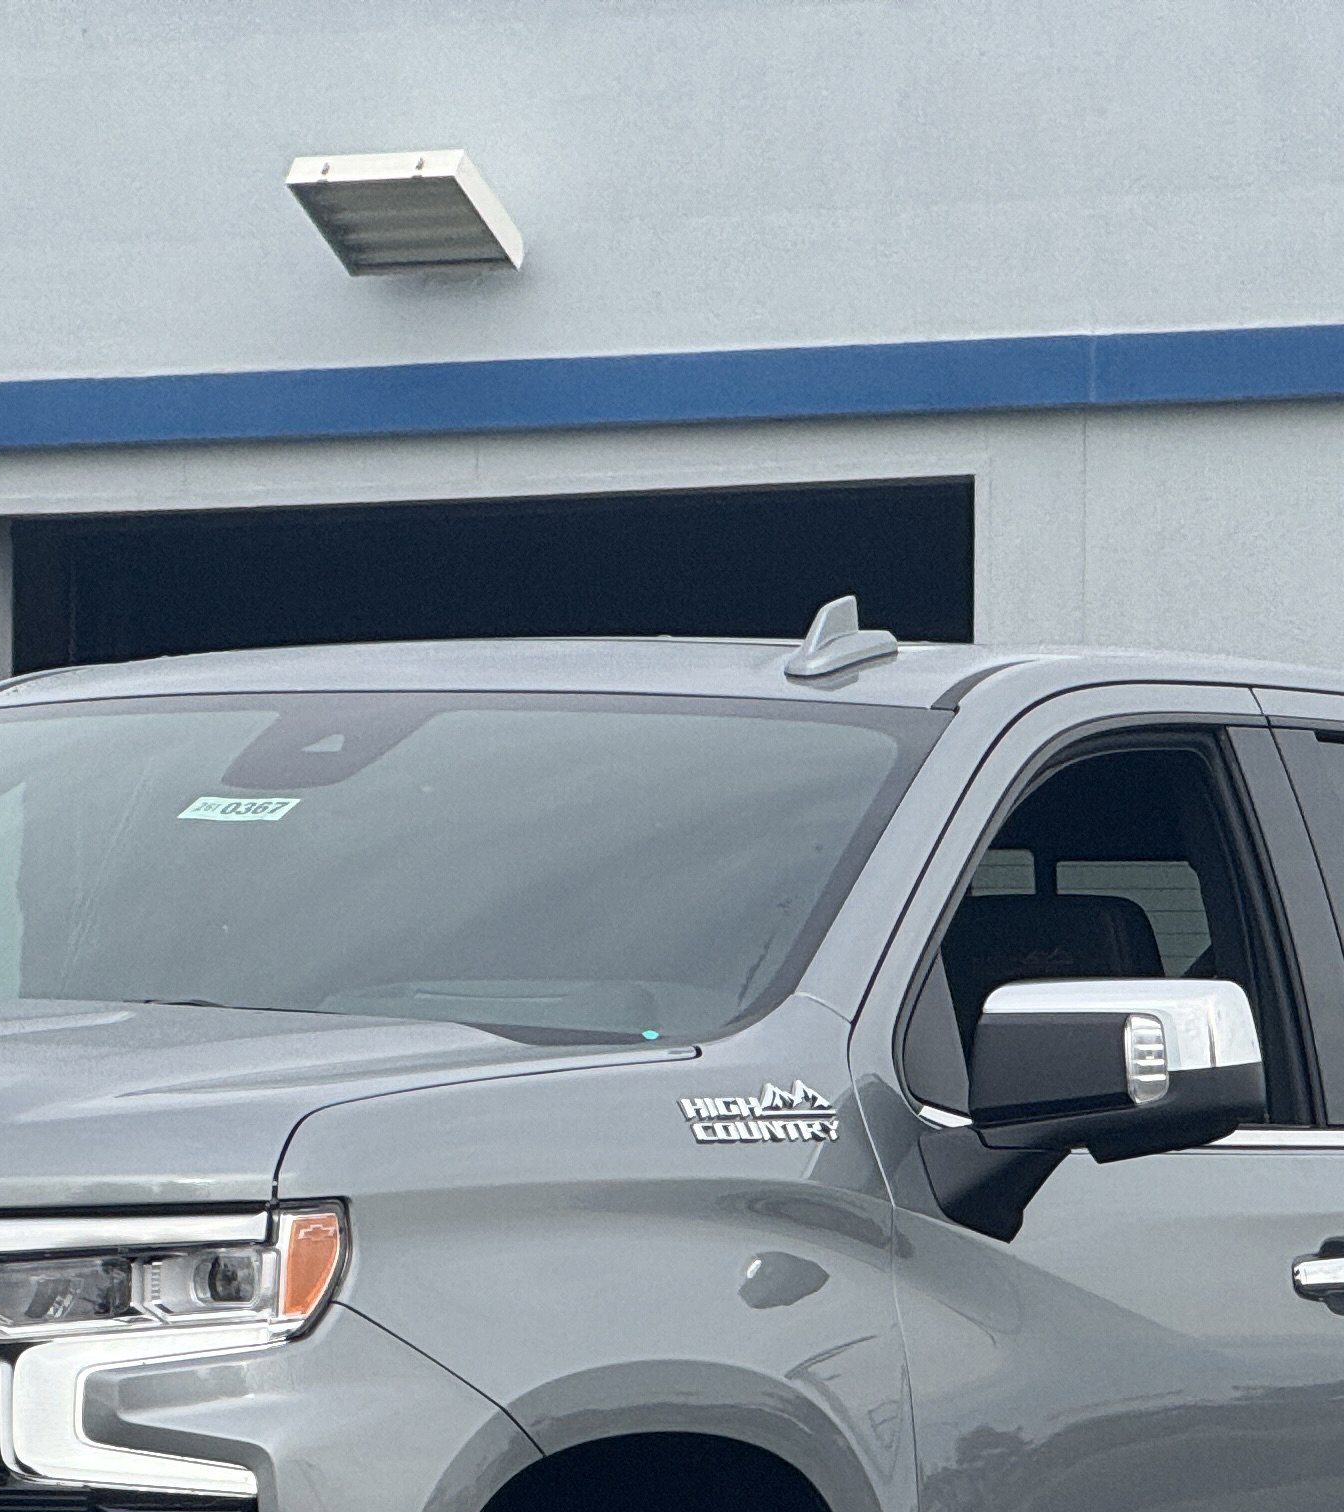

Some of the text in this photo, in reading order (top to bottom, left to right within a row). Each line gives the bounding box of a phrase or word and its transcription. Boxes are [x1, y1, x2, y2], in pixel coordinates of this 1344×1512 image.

[220, 801, 290, 815] 0367
[680, 1096, 762, 1120] HIGH
[691, 1120, 839, 1142] COUNTRY
